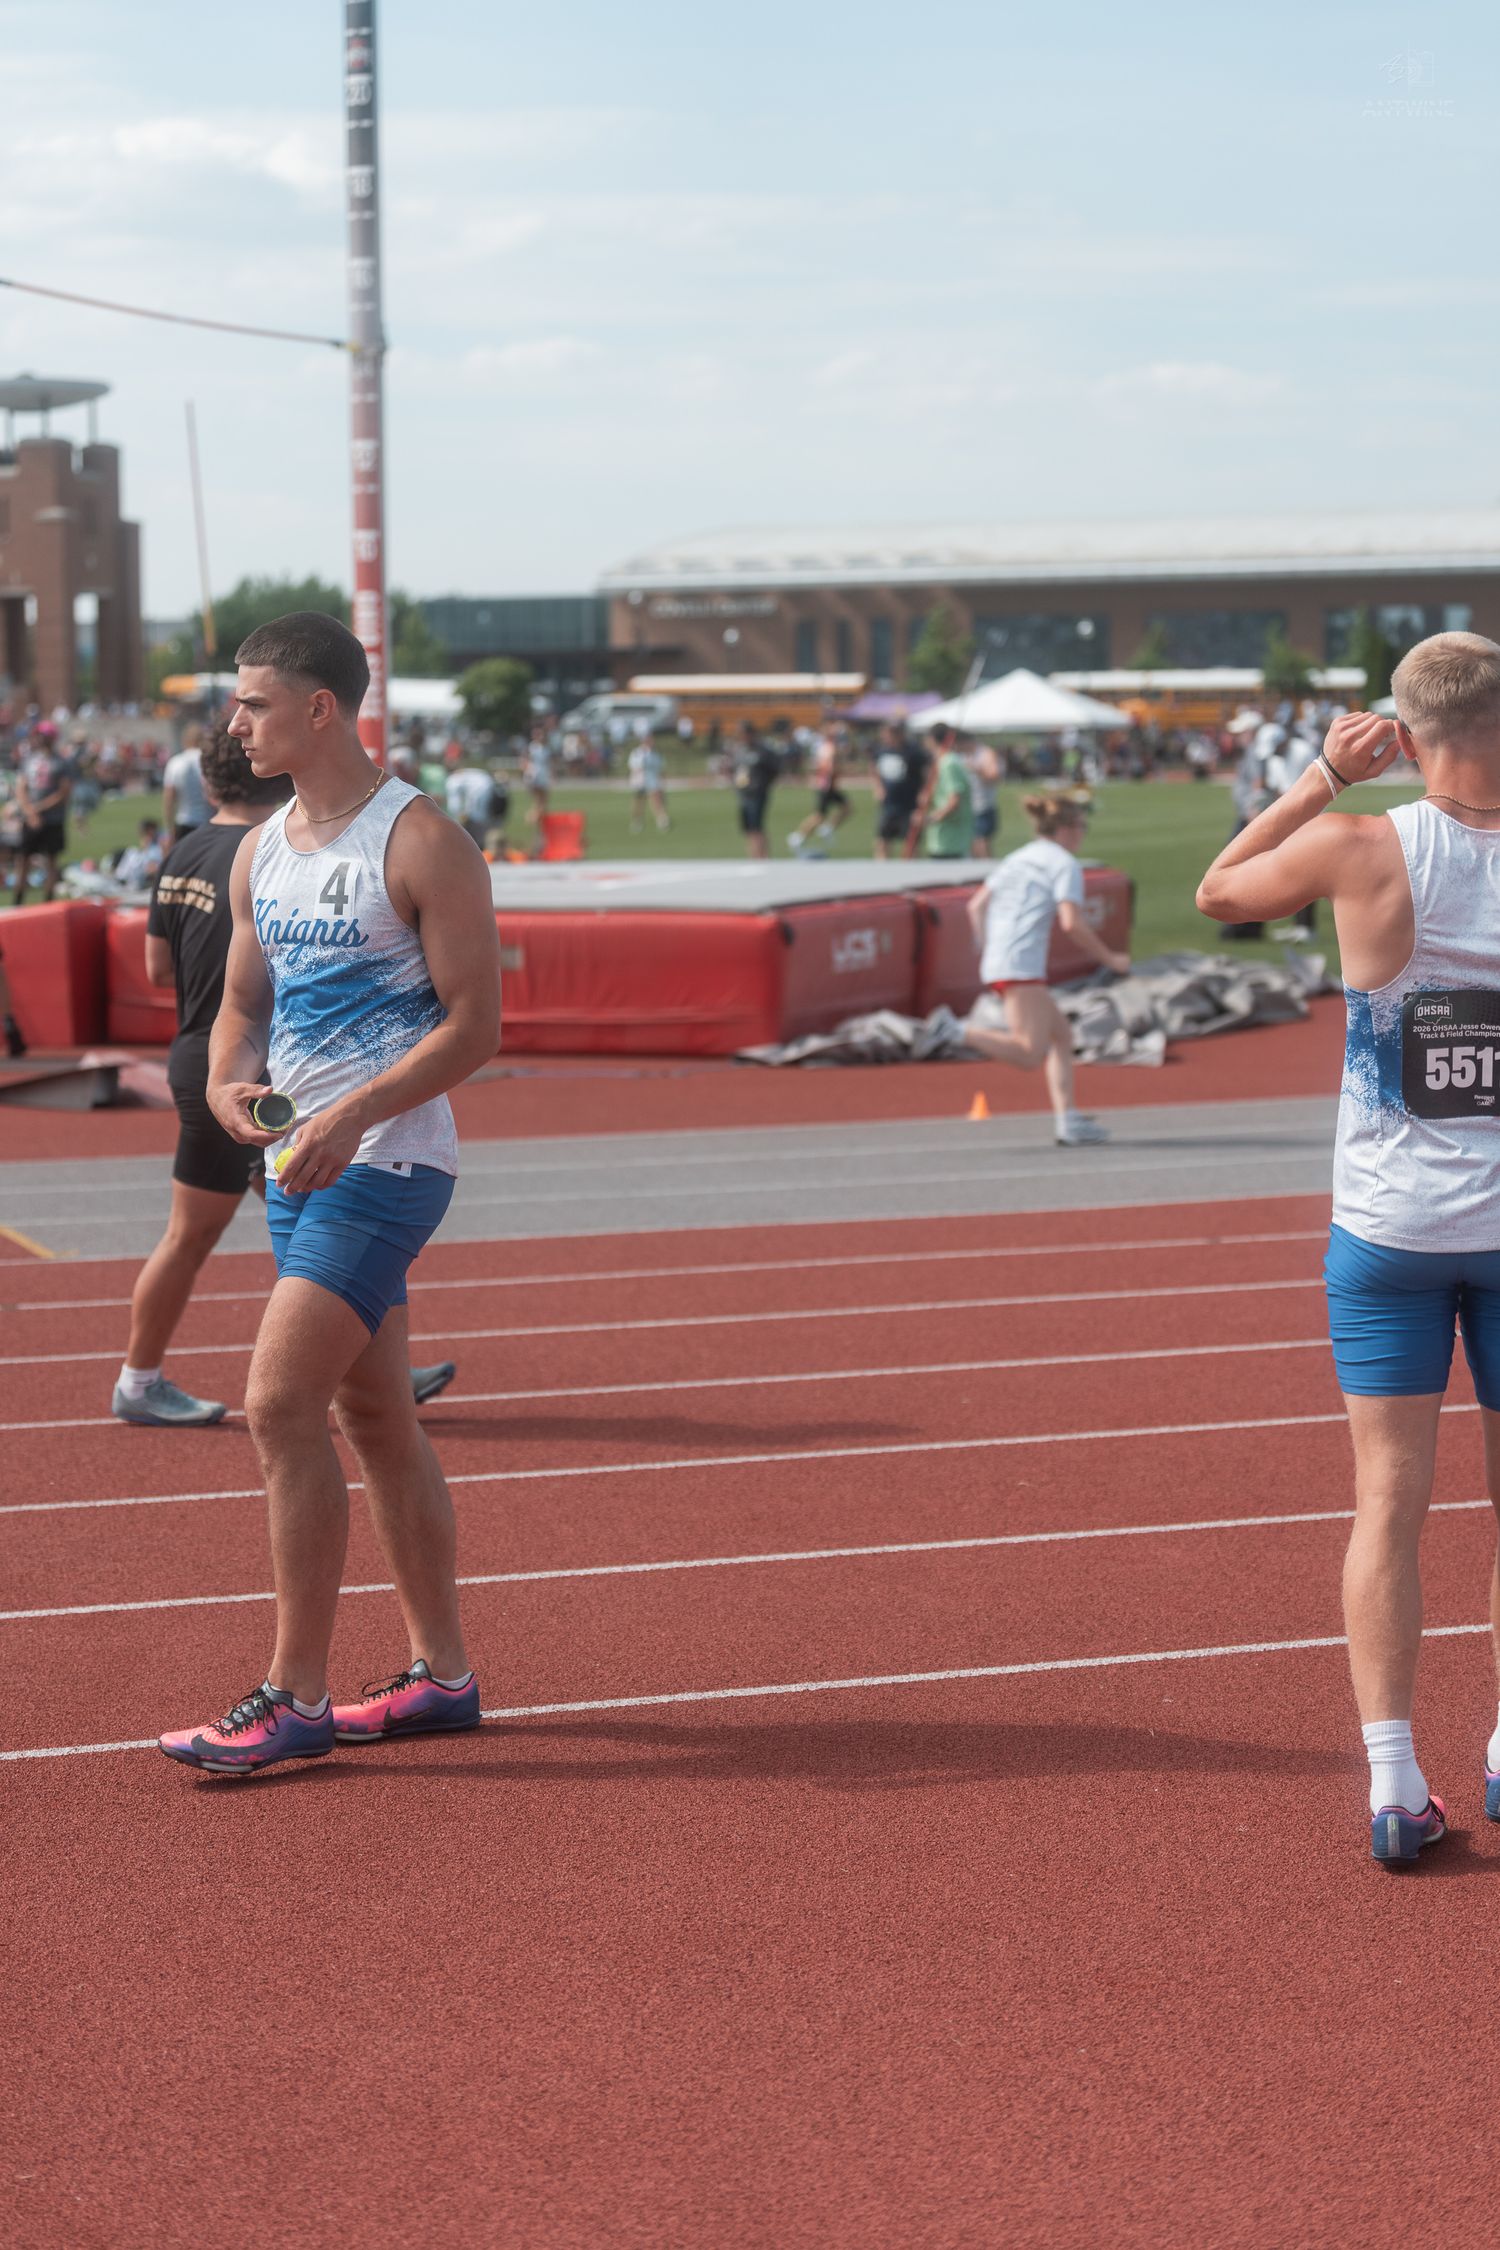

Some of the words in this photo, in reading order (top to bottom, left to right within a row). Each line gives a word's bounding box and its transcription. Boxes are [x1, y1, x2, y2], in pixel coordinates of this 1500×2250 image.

[319, 861, 352, 916] 4
[255, 898, 370, 966] Knights
[1417, 1005, 1450, 1017] OHSAA
[1432, 1024, 1458, 1032] OHSAA
[1446, 1030, 1463, 1038] Field
